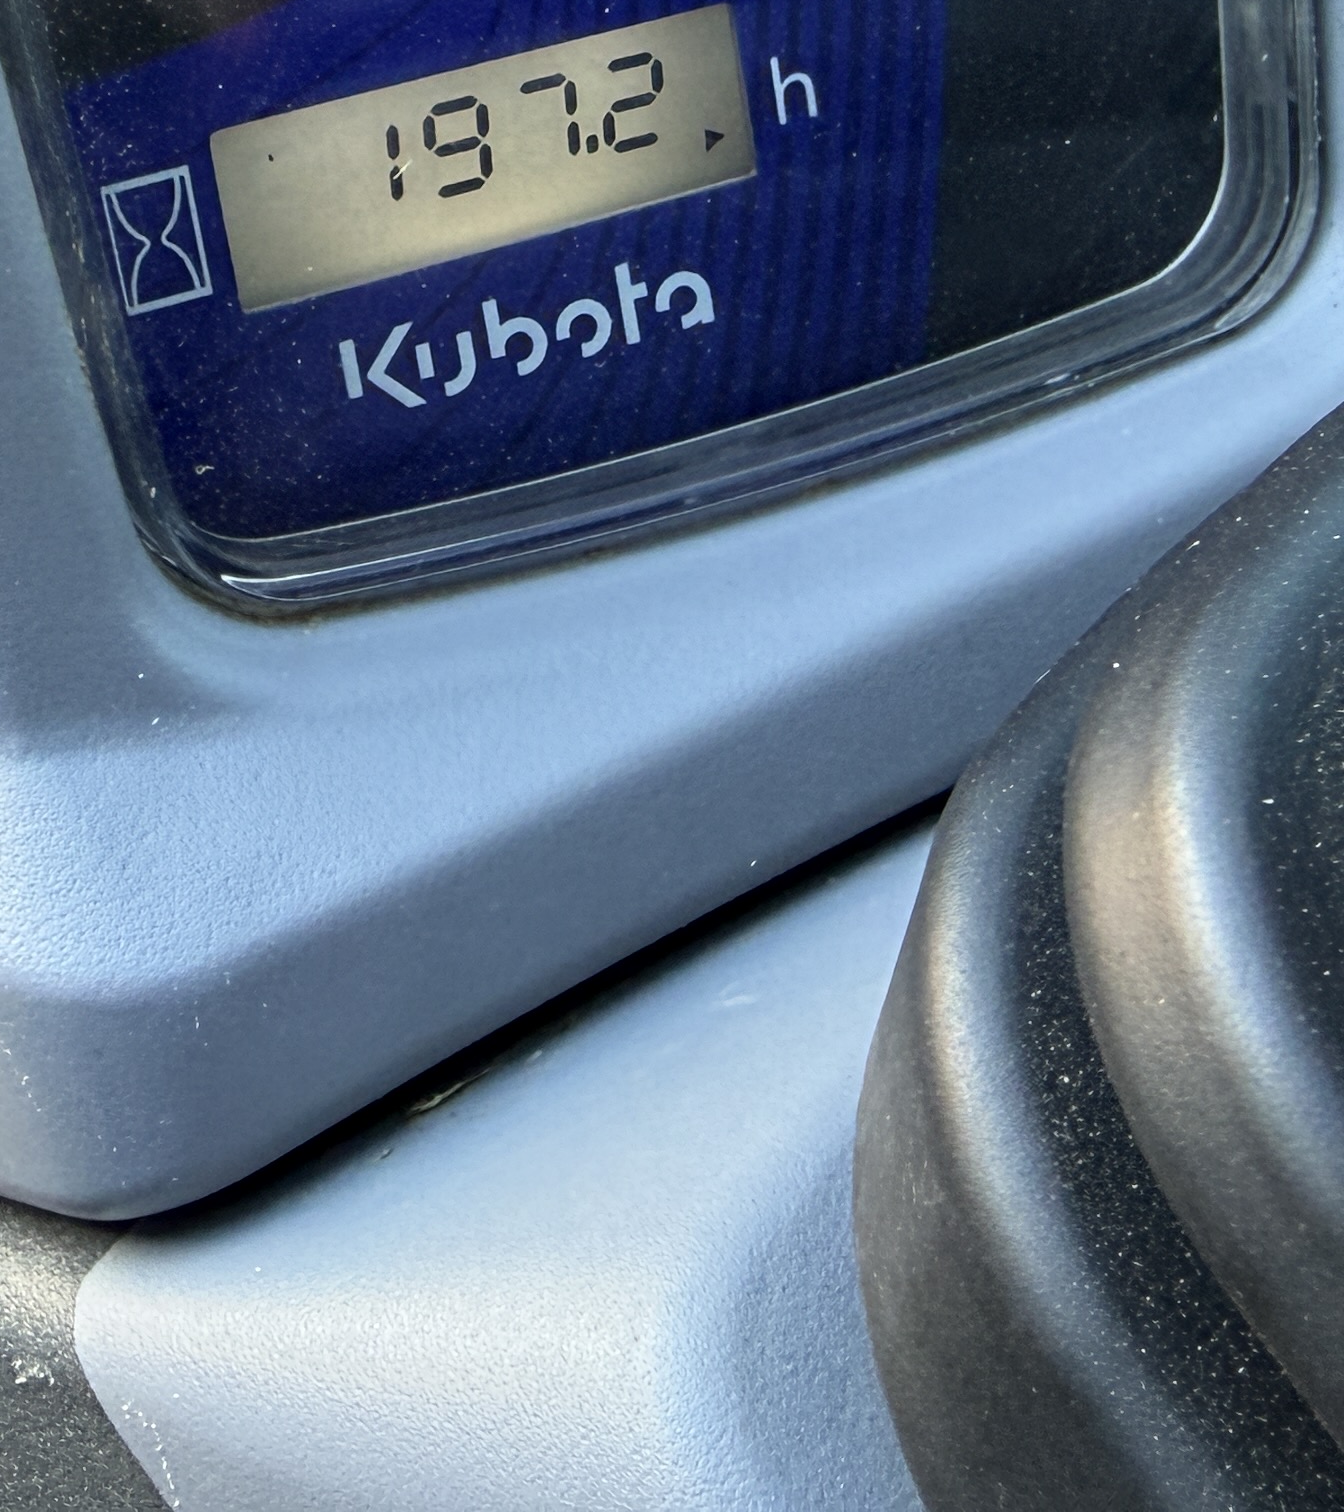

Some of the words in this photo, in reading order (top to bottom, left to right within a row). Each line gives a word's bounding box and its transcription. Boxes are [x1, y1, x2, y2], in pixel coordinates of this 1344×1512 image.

[385, 51, 665, 201] 197.2
[769, 56, 820, 125] h
[338, 261, 715, 409] Kubota
